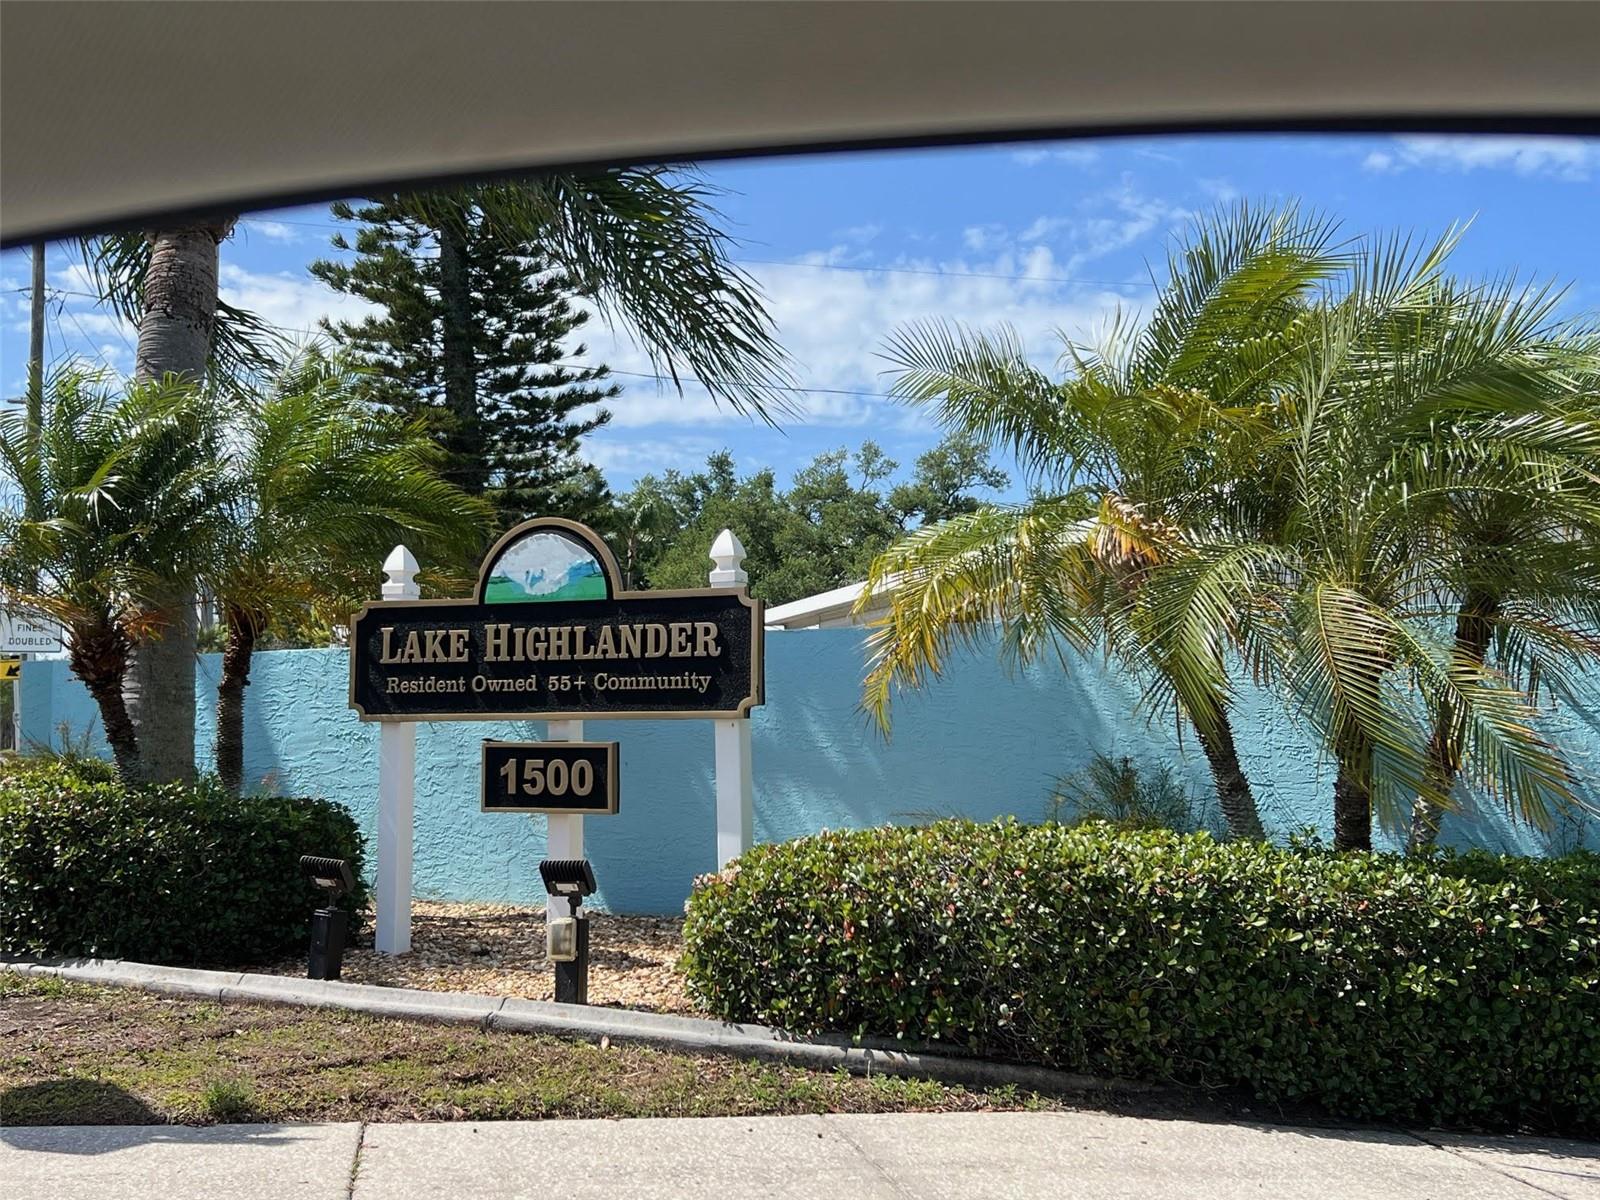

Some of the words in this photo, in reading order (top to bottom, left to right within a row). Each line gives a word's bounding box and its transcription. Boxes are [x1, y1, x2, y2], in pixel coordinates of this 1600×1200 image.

[8, 637, 52, 646] DOUBLED
[379, 627, 470, 665] LAKE
[483, 621, 722, 663] HIGHLANDER
[386, 676, 465, 694] Resident
[472, 674, 537, 692] Owned
[548, 675, 586, 692] 55+
[594, 671, 712, 693] Community
[500, 758, 594, 796] 1500
